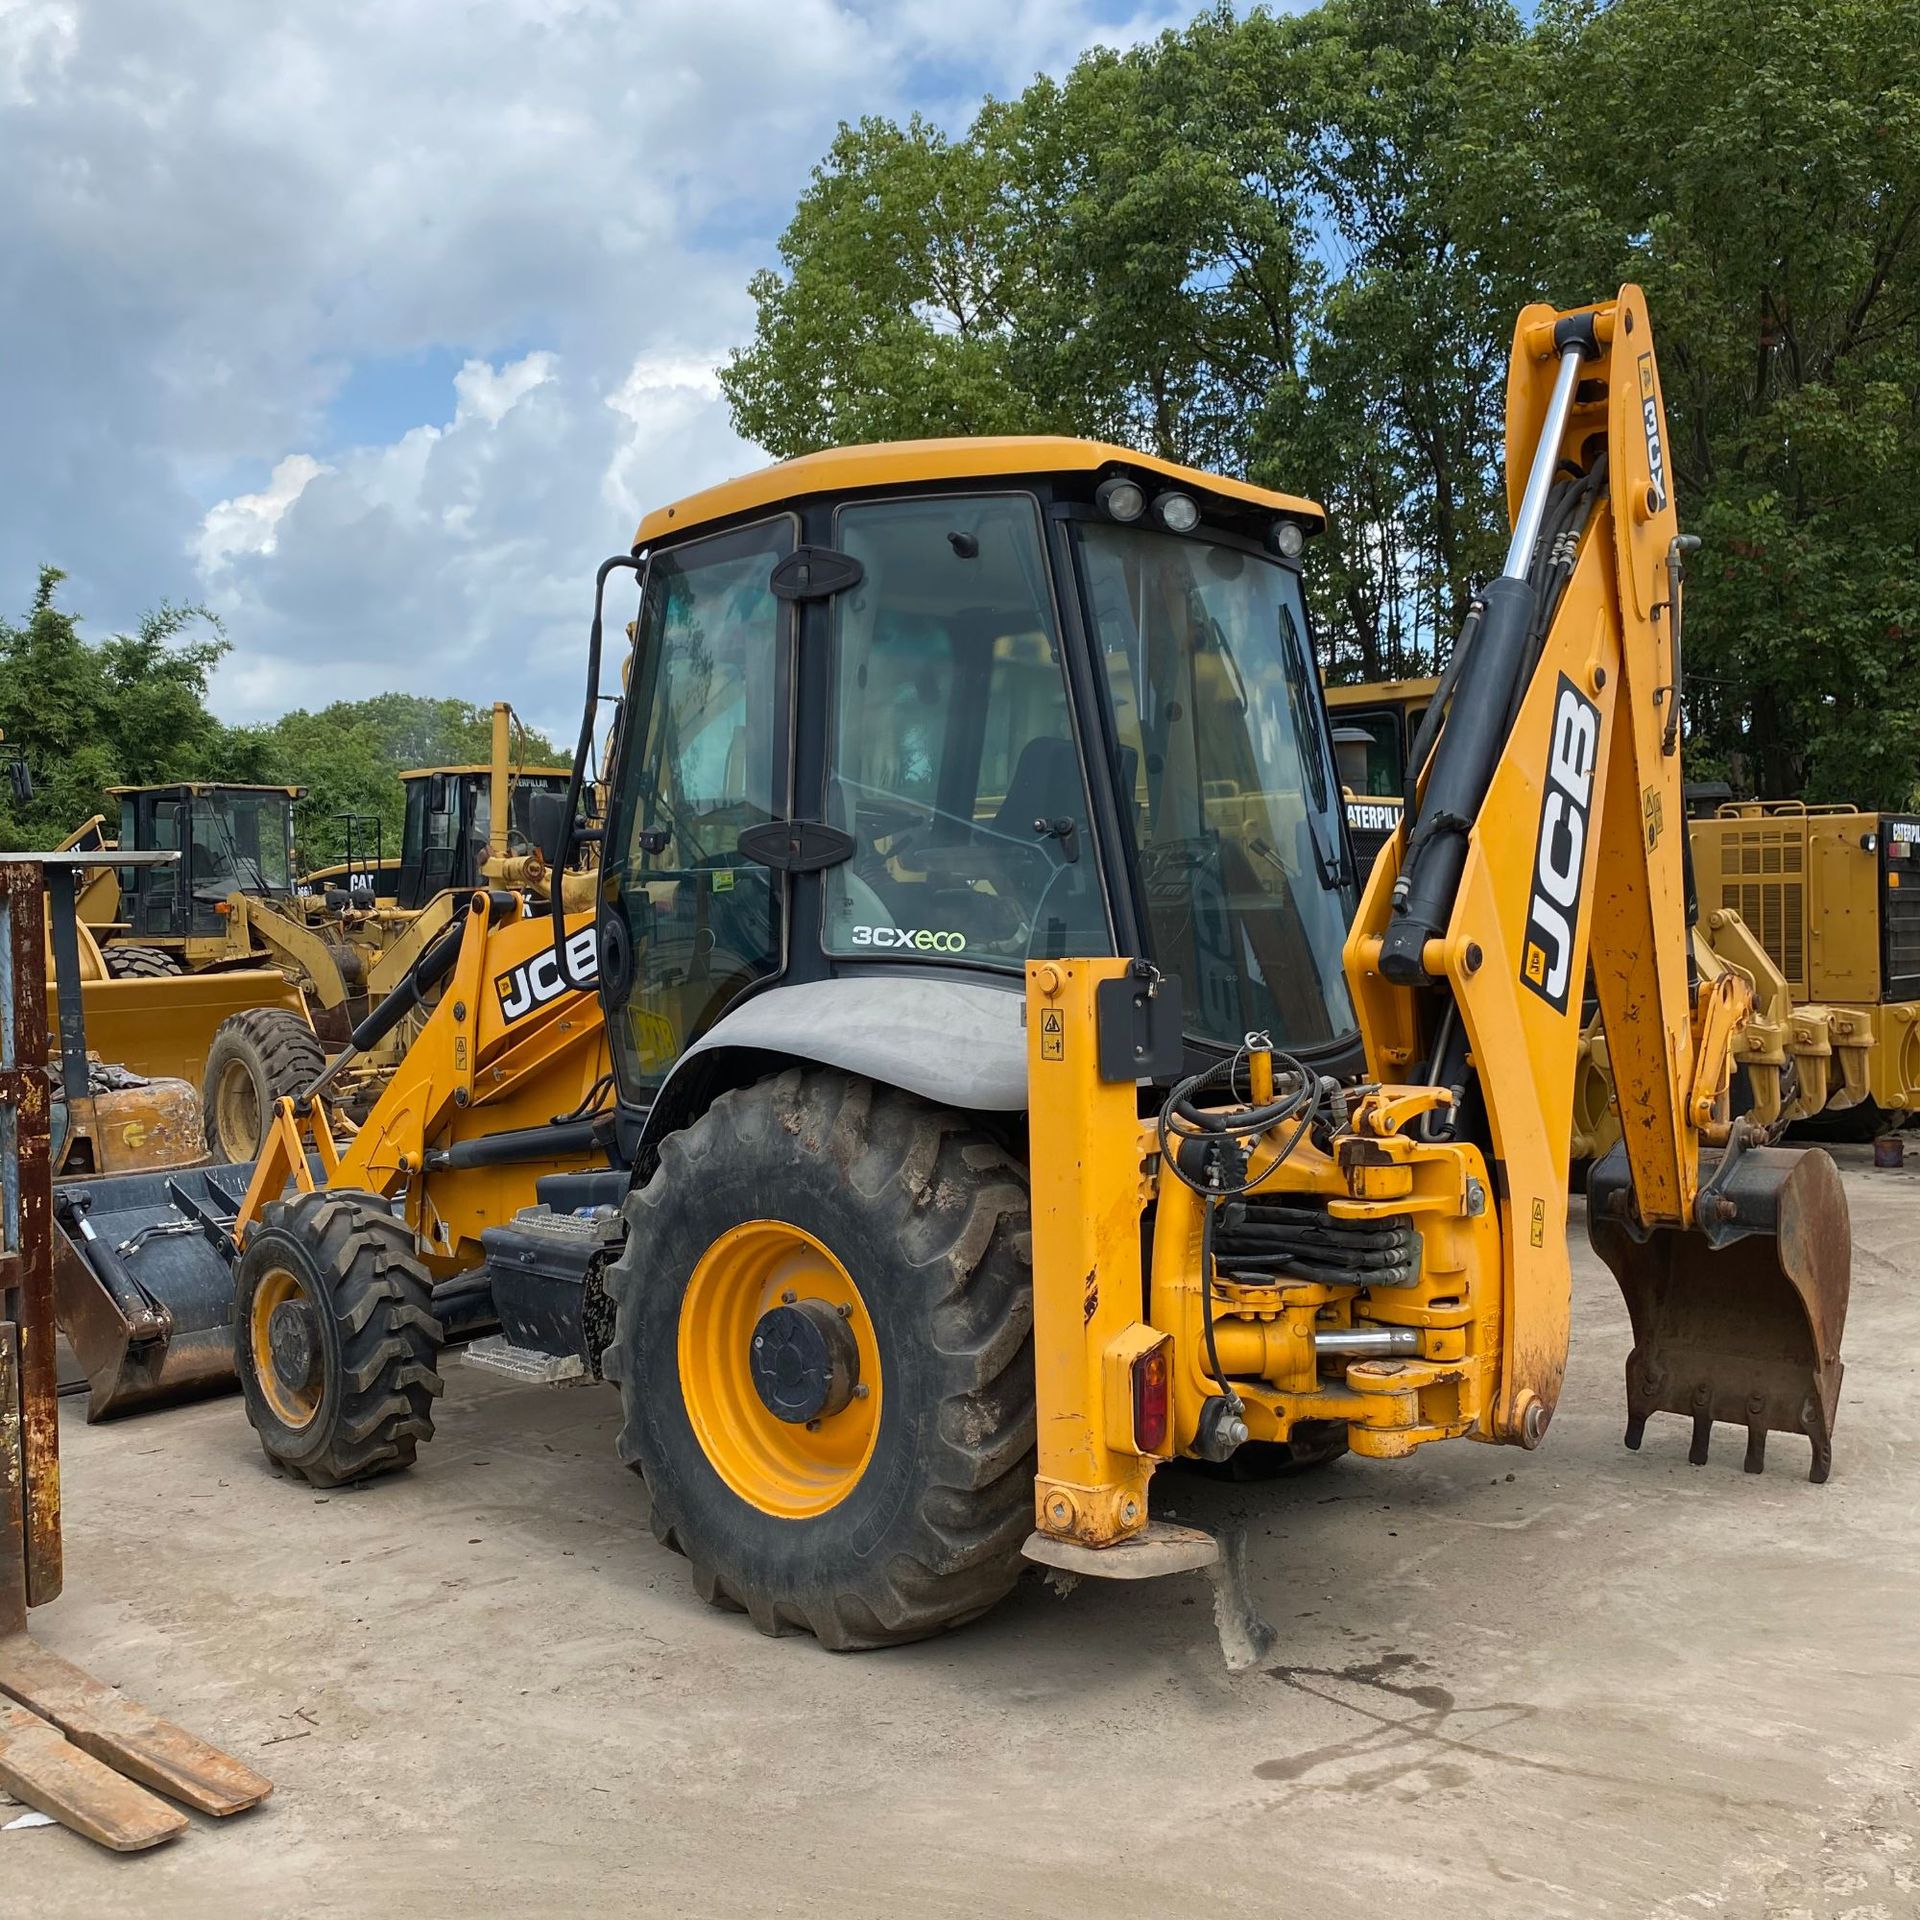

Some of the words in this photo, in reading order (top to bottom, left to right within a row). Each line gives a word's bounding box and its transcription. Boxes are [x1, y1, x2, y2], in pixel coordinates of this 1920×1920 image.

[1644, 400, 1666, 500] 3CX
[350, 872, 374, 893] CAT
[1532, 690, 1596, 999] JCB
[503, 928, 598, 1018] JCB
[852, 925, 966, 953] 3CXeco
